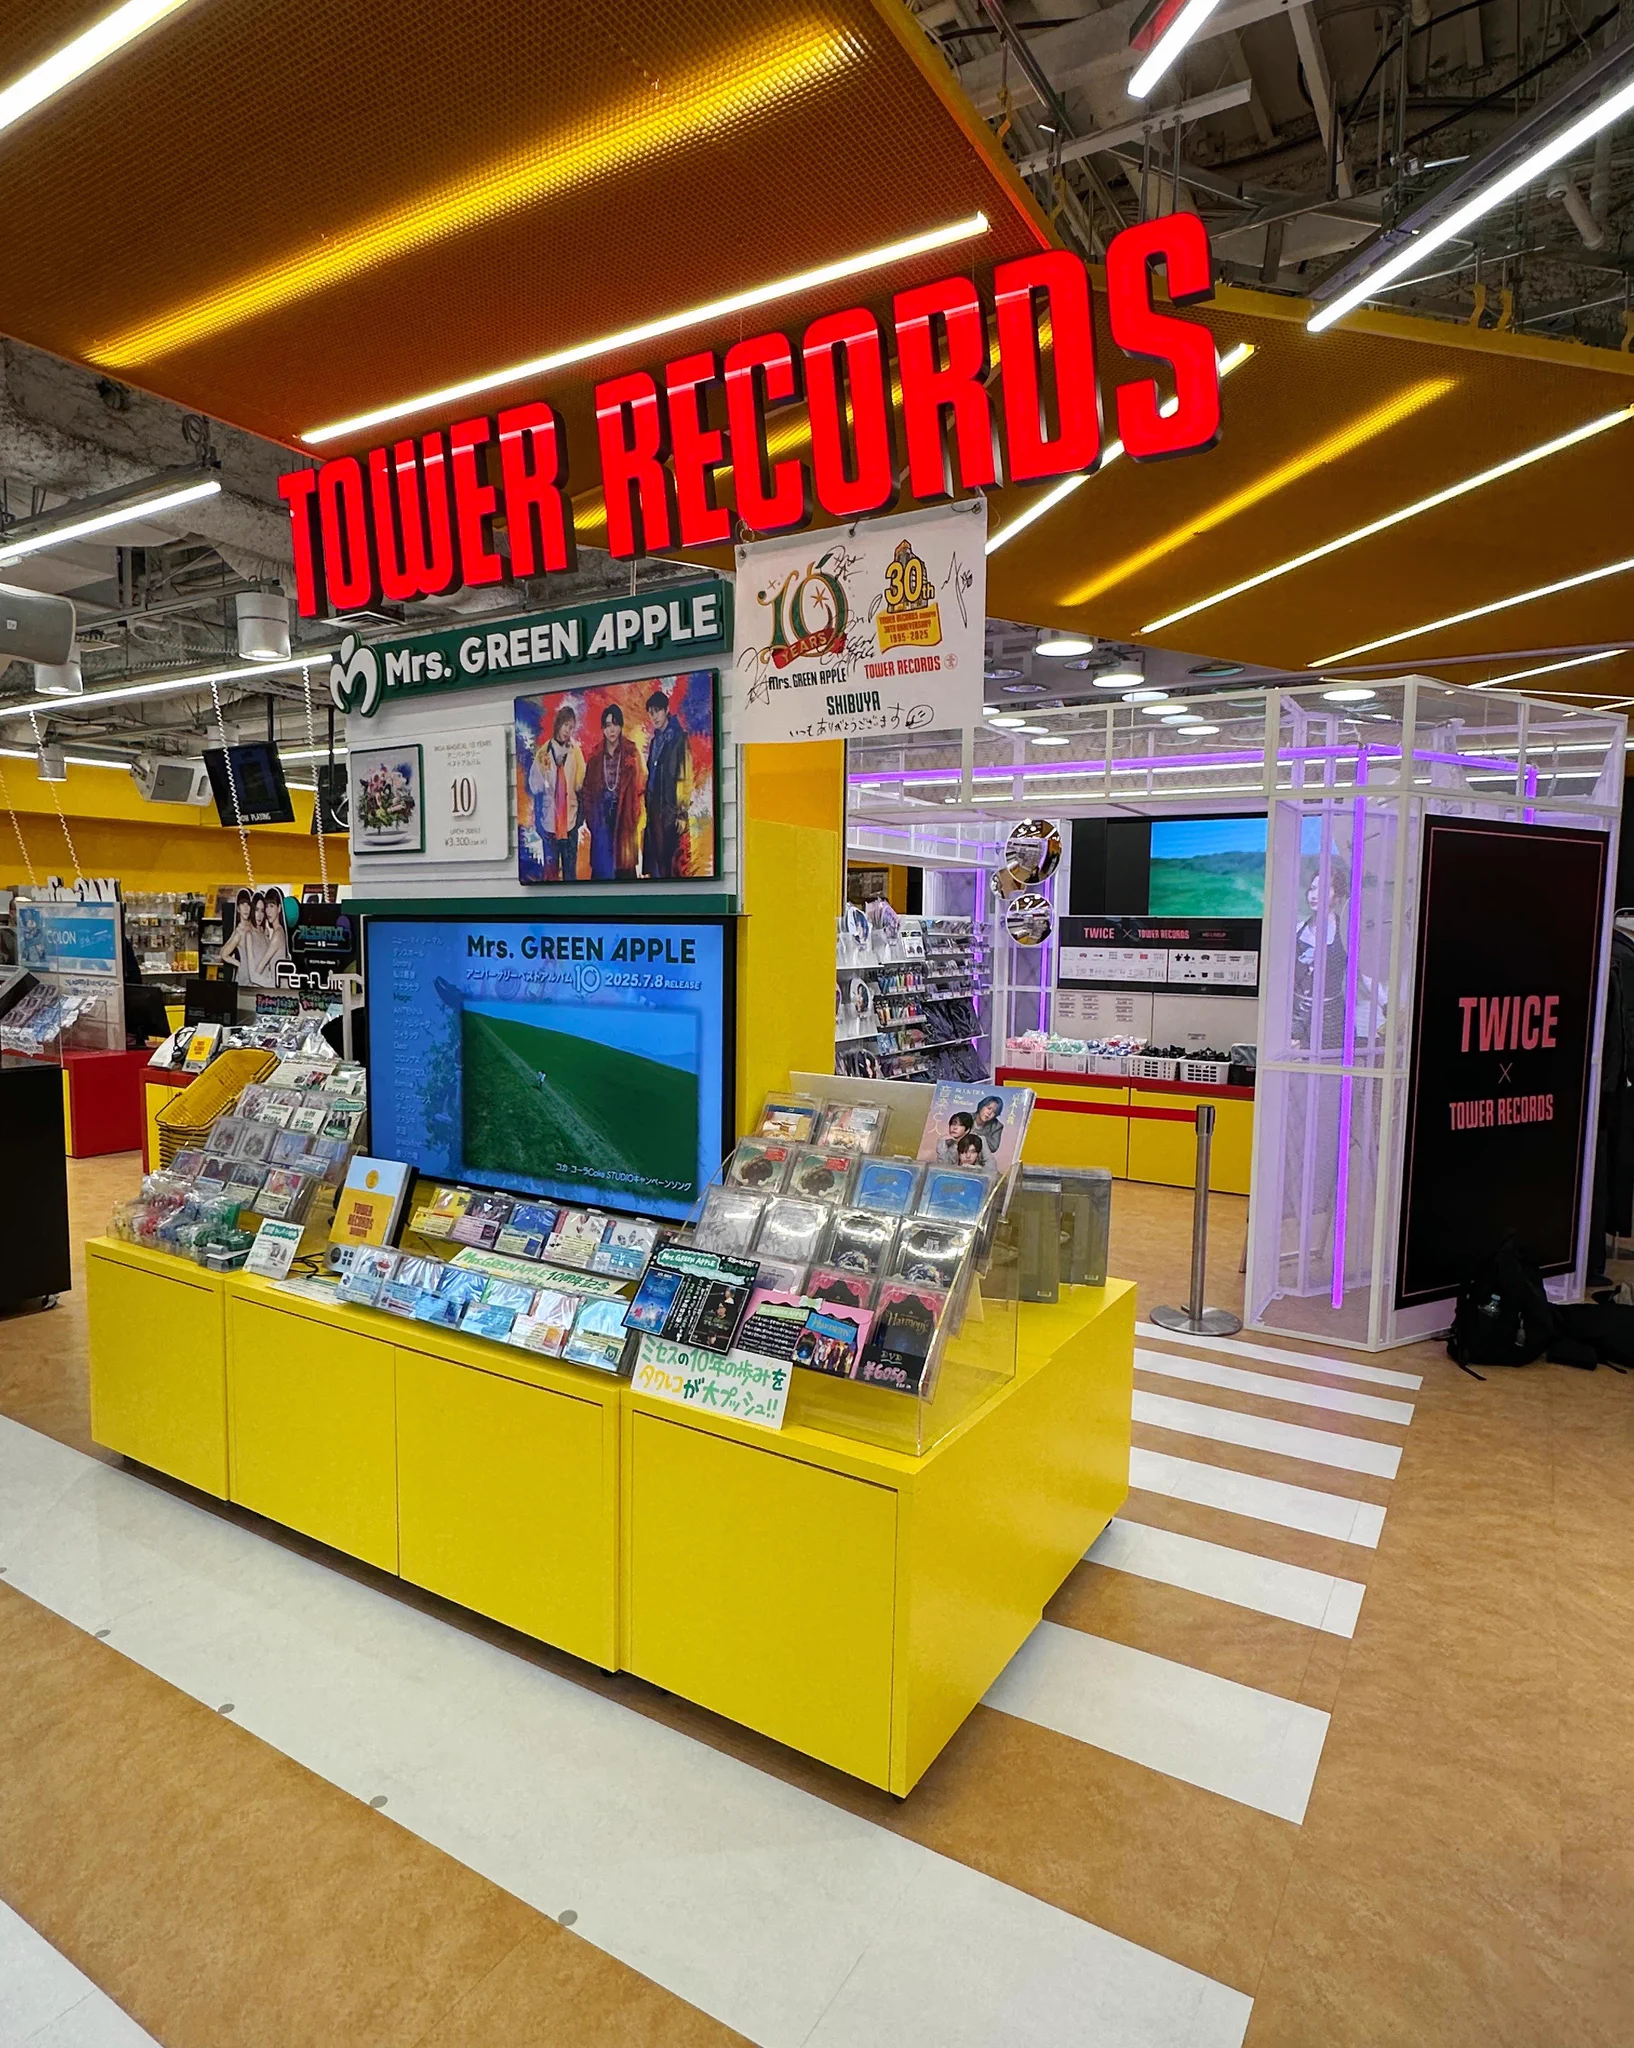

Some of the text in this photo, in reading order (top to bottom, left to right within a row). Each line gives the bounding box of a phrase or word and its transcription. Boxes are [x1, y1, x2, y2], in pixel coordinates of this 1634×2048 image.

[278, 211, 1222, 619] TOWER RECORDS
[885, 558, 936, 604] 30th
[384, 593, 719, 687] Mrs. GREEN APPLE
[780, 632, 827, 663] YEARS
[768, 668, 847, 690] Mrs. GREEN APPLE
[864, 661, 895, 679] TOWER
[897, 655, 941, 675] RECORDS
[826, 691, 881, 716] SHIBUYA
[790, 702, 905, 738] いつもありがとうございます
[450, 777, 474, 813] 10
[47, 930, 77, 945] COLON
[1084, 928, 1115, 939] TWICE
[1137, 929, 1159, 938] TOWER
[1160, 929, 1190, 939] RECORDS
[467, 935, 696, 964] Mrs. GREEN APPLE
[604, 973, 664, 989] 2025.7.8
[664, 979, 701, 990] RELEASE
[1458, 995, 1560, 1053] TWICE
[1449, 1094, 1553, 1131] TOWER RECORDS
[606, 1170, 692, 1191] STUDIOキャンペーンソング
[347, 1213, 374, 1230] RECORDS
[354, 1202, 374, 1216] TOWER
[641, 1335, 787, 1391] ミセスの10年の歩みを
[638, 1364, 779, 1419] タワレコが大プッシュ!!
